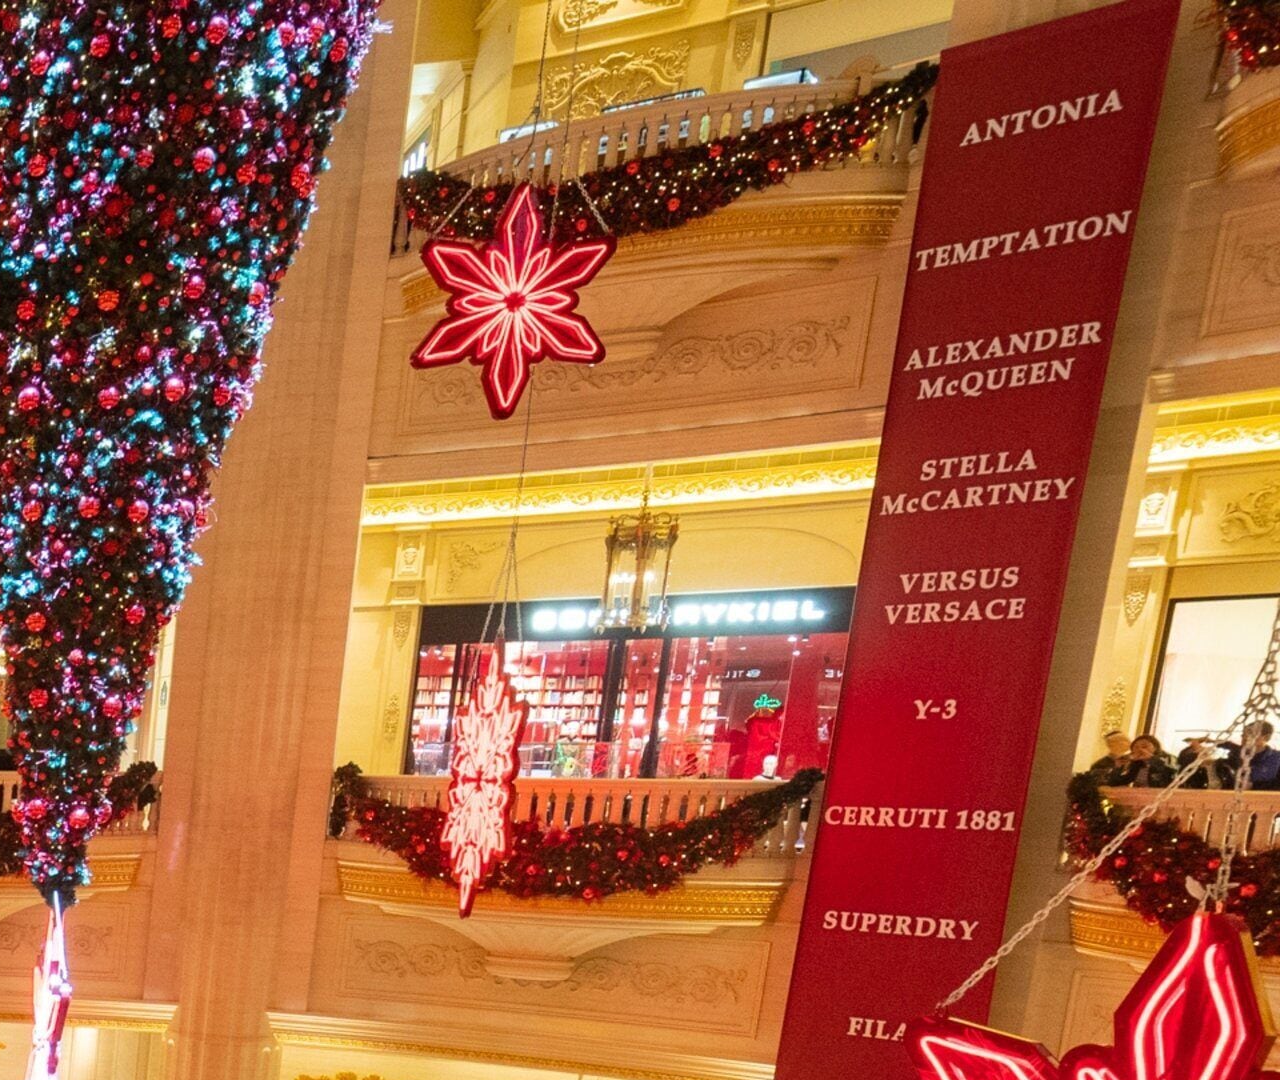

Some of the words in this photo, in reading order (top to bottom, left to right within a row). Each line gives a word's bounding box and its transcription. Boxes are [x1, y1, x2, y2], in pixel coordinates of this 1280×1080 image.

[959, 88, 1124, 148] ANTONIA
[915, 210, 1133, 271] TEMPTATION
[903, 321, 1102, 372] ALEXANDER
[917, 358, 1076, 400] McQUEEN
[919, 449, 1037, 481] STELLA
[879, 476, 1076, 516] McCARTNEY
[899, 566, 1020, 594] VERSUS
[884, 597, 1027, 625] VERSACE
[913, 698, 958, 720] Y-3
[824, 805, 948, 830] CERRUTI
[955, 809, 1016, 832] 1881
[822, 909, 980, 942] SUPERDRY
